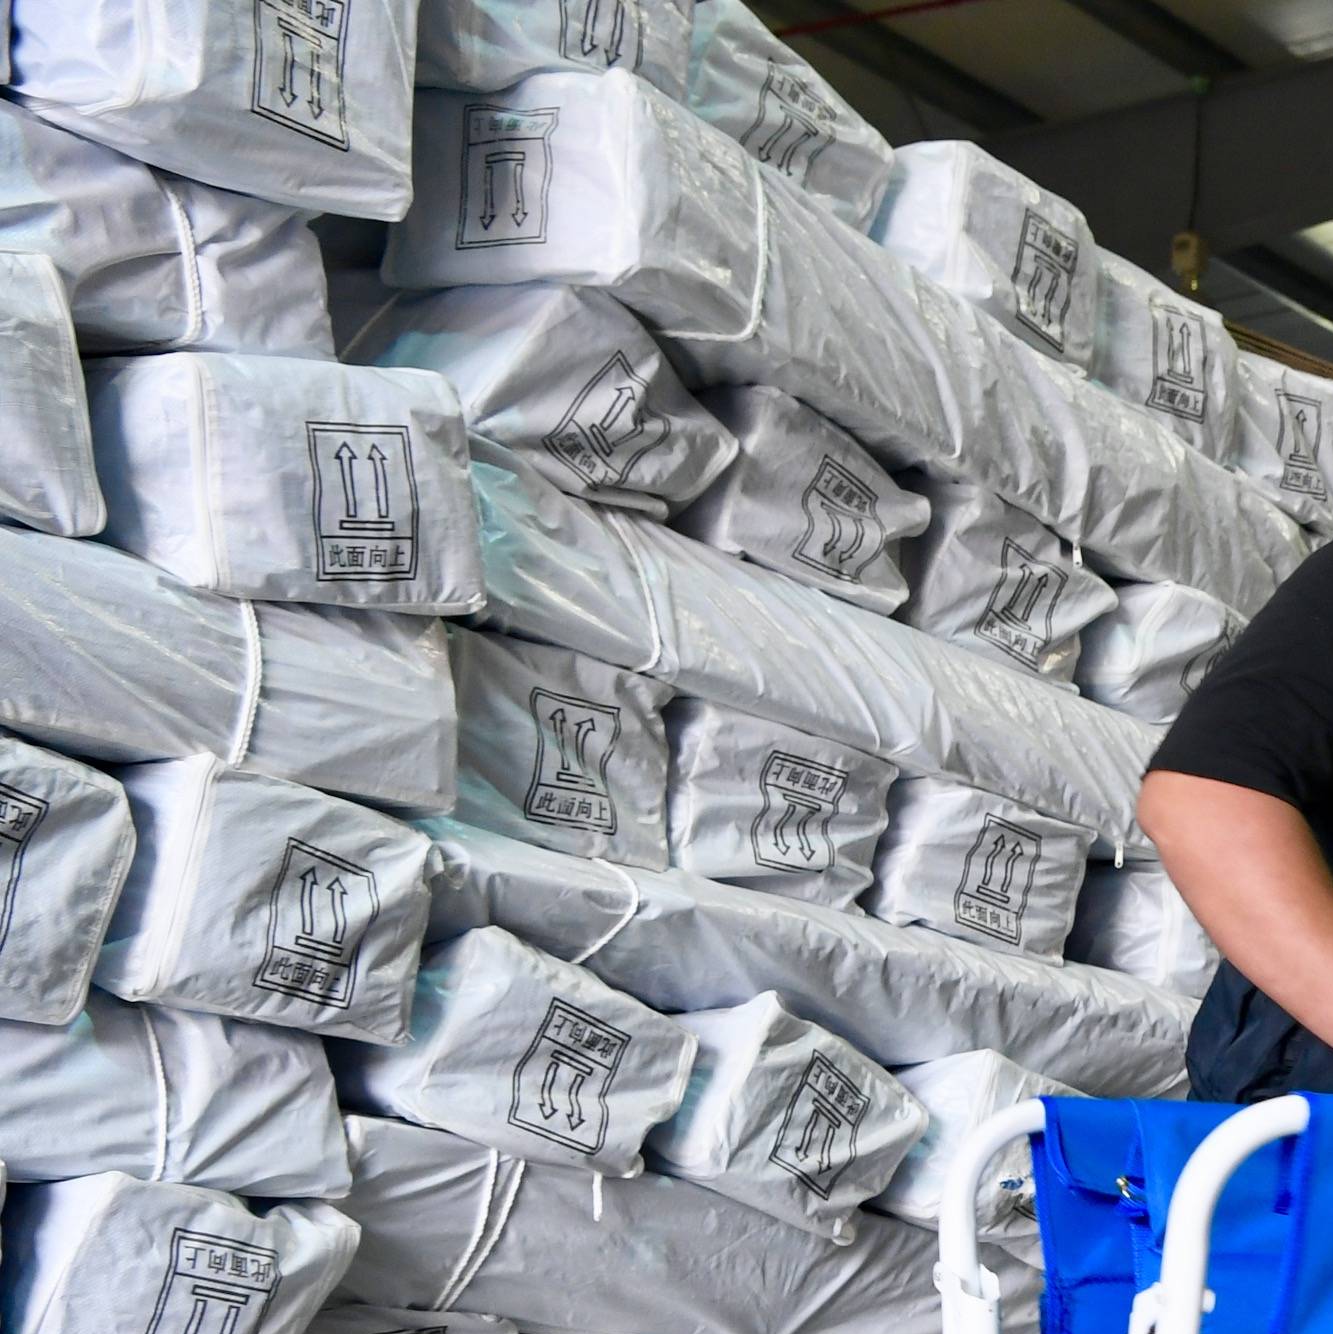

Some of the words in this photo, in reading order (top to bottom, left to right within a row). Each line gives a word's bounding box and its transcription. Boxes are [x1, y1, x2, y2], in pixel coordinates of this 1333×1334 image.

[329, 544, 405, 569] 此面向上
[772, 761, 836, 793] 此面向上
[535, 793, 608, 821] 此面向上
[962, 900, 1014, 933] 此面向上
[273, 955, 340, 991] 此面向上
[553, 1015, 622, 1060] 此面向上
[813, 1064, 860, 1119] 此面向上
[185, 1246, 274, 1282] 此面向上
